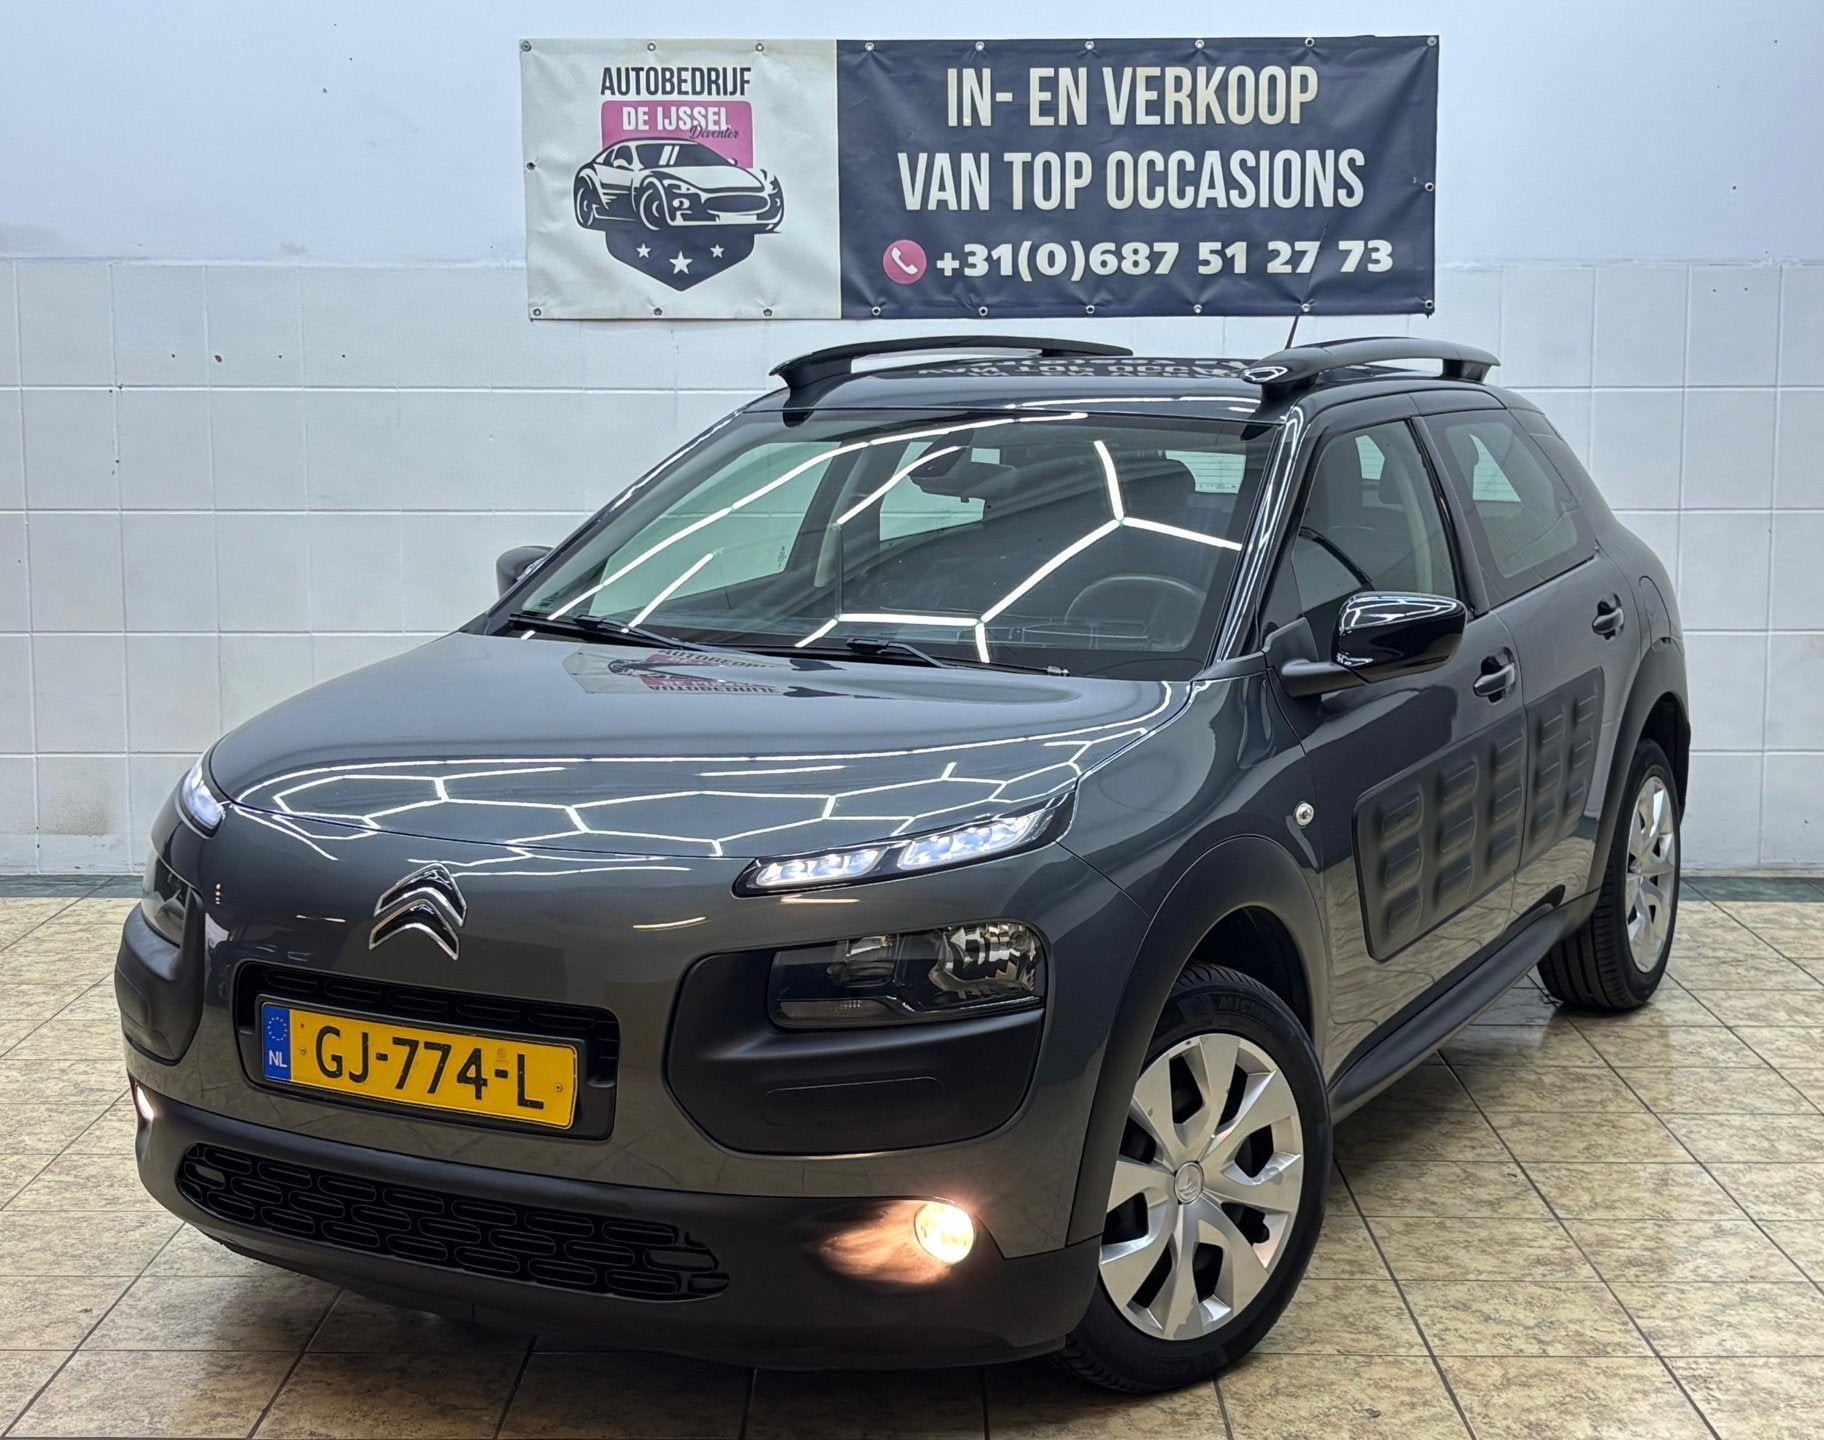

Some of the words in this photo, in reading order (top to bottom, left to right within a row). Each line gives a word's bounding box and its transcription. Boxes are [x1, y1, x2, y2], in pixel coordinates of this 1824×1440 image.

[600, 66, 752, 96] AUTOBEDRIJF
[947, 67, 1013, 127] IN-
[1029, 67, 1088, 126] EN
[1102, 65, 1318, 126] VERKOOP
[622, 106, 649, 131] DE
[656, 106, 732, 131] IJSSEL
[897, 152, 990, 211] VAN
[1003, 151, 1093, 210] TOP
[1106, 148, 1366, 210] OCCASIONS
[936, 240, 1179, 282] +31(0)687
[1198, 241, 1247, 275] 51
[1266, 241, 1321, 274] 27
[1338, 240, 1394, 273] 73
[268, 1050, 288, 1069] NL
[314, 1025, 545, 1111] GJ-774-L
